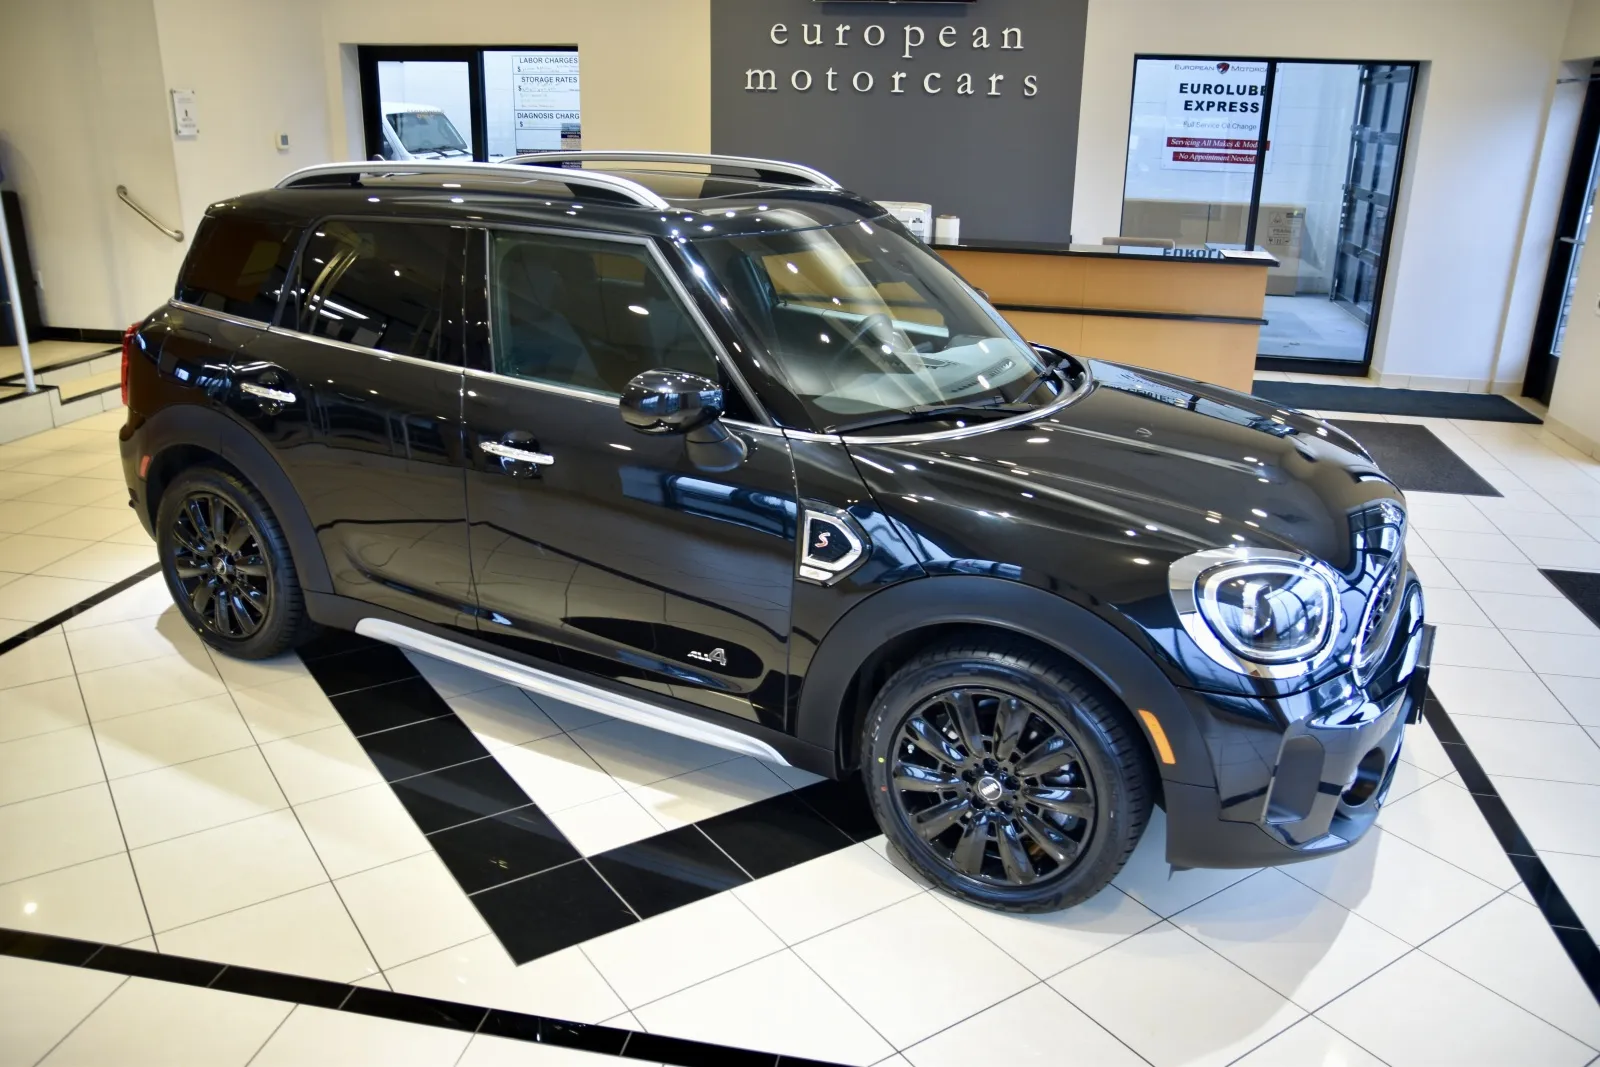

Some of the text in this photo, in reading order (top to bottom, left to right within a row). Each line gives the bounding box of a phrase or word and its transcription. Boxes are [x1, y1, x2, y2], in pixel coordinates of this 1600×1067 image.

[770, 22, 1025, 59] european
[744, 67, 1038, 97] motorcars
[1183, 100, 1260, 113] EXPRESS
[1232, 123, 1257, 131] Change
[1171, 138, 1201, 147] Servicing
[1189, 154, 1230, 162] Appointment
[814, 532, 831, 548] S
